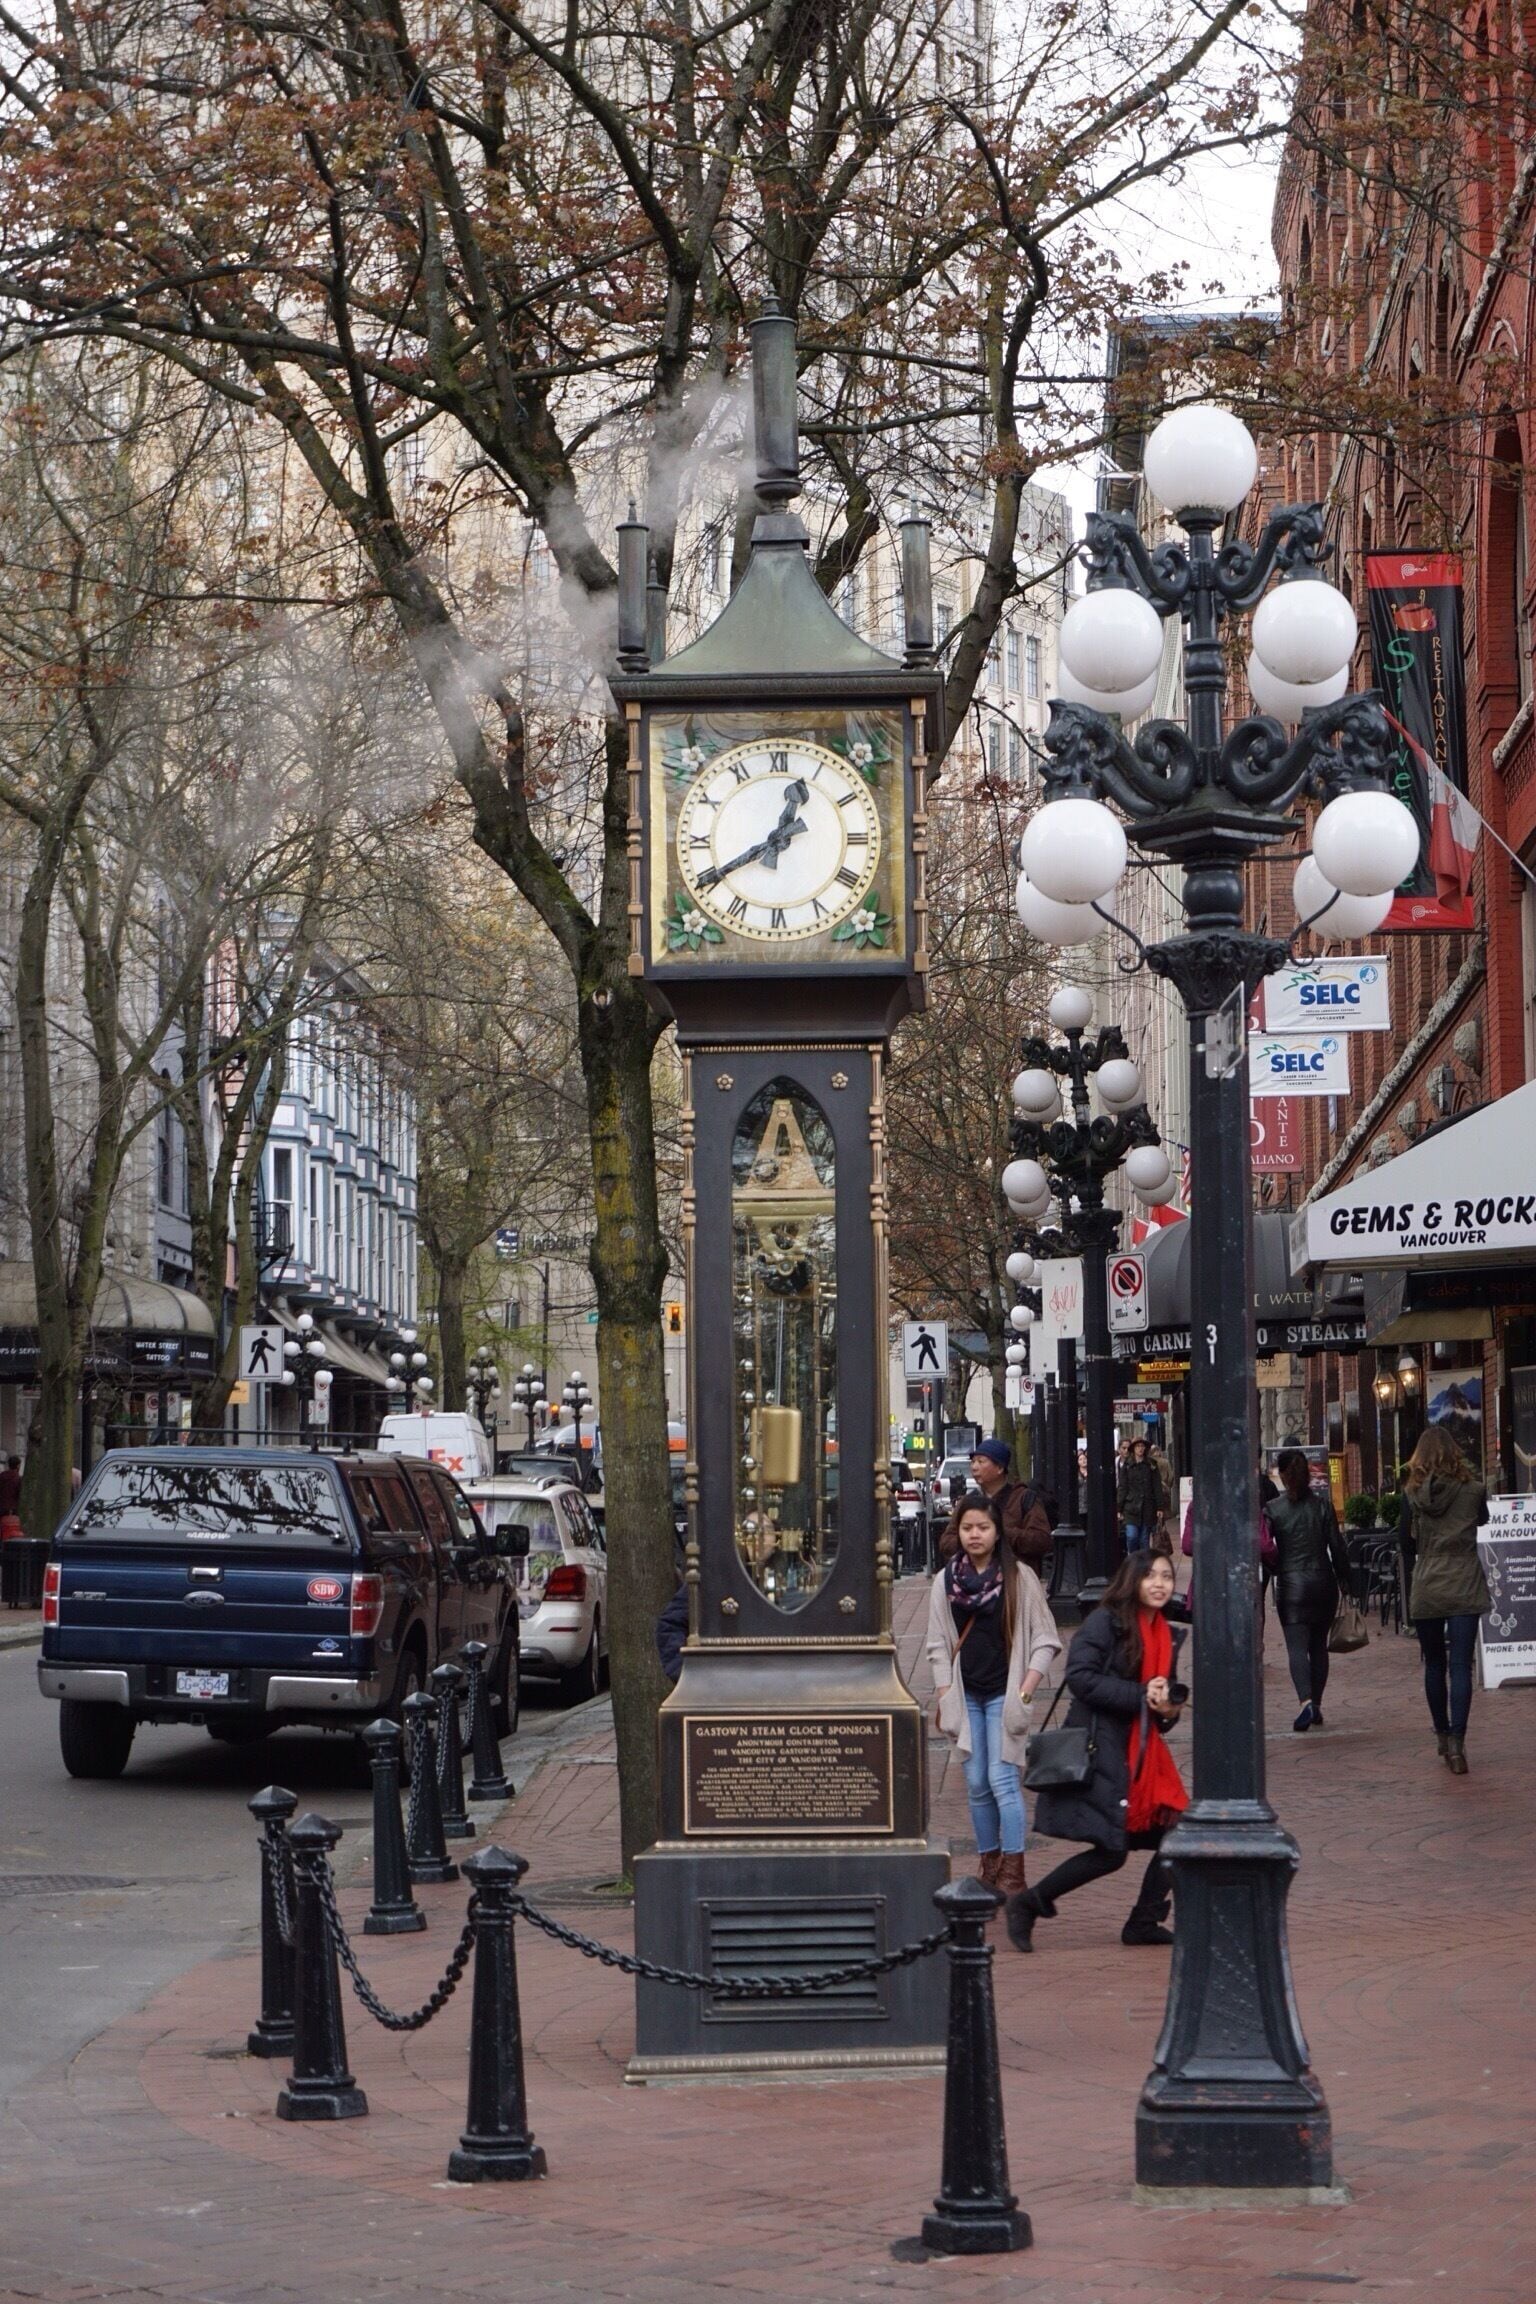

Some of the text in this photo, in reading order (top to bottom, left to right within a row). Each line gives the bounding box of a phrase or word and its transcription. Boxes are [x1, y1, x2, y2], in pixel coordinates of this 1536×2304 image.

[1432, 636, 1447, 779] RESTAURANT
[769, 752, 788, 773] XII
[728, 762, 750, 785] XI
[1300, 983, 1361, 1006] SELC
[1271, 1053, 1325, 1073] SELC
[1330, 1195, 1536, 1236] GEMS & ROCK
[1400, 1230, 1487, 1248] VANCOUVER
[1269, 1291, 1314, 1305] WATE
[1287, 1323, 1349, 1343] STEAK
[1114, 1402, 1158, 1413] SMILEY'S
[1512, 1513, 1520, 1524] &
[314, 1584, 336, 1596] SBW
[696, 1725, 880, 1737] GASTOWN STEAM CLOCK SPONSORS
[736, 1738, 840, 1748] ANONYMOUS CONTRIBUTOR
[712, 1747, 864, 1756] THE VANCOUVER GASTOWN LIONS CLUB
[790, 1755, 838, 1764] VANCOUVER
